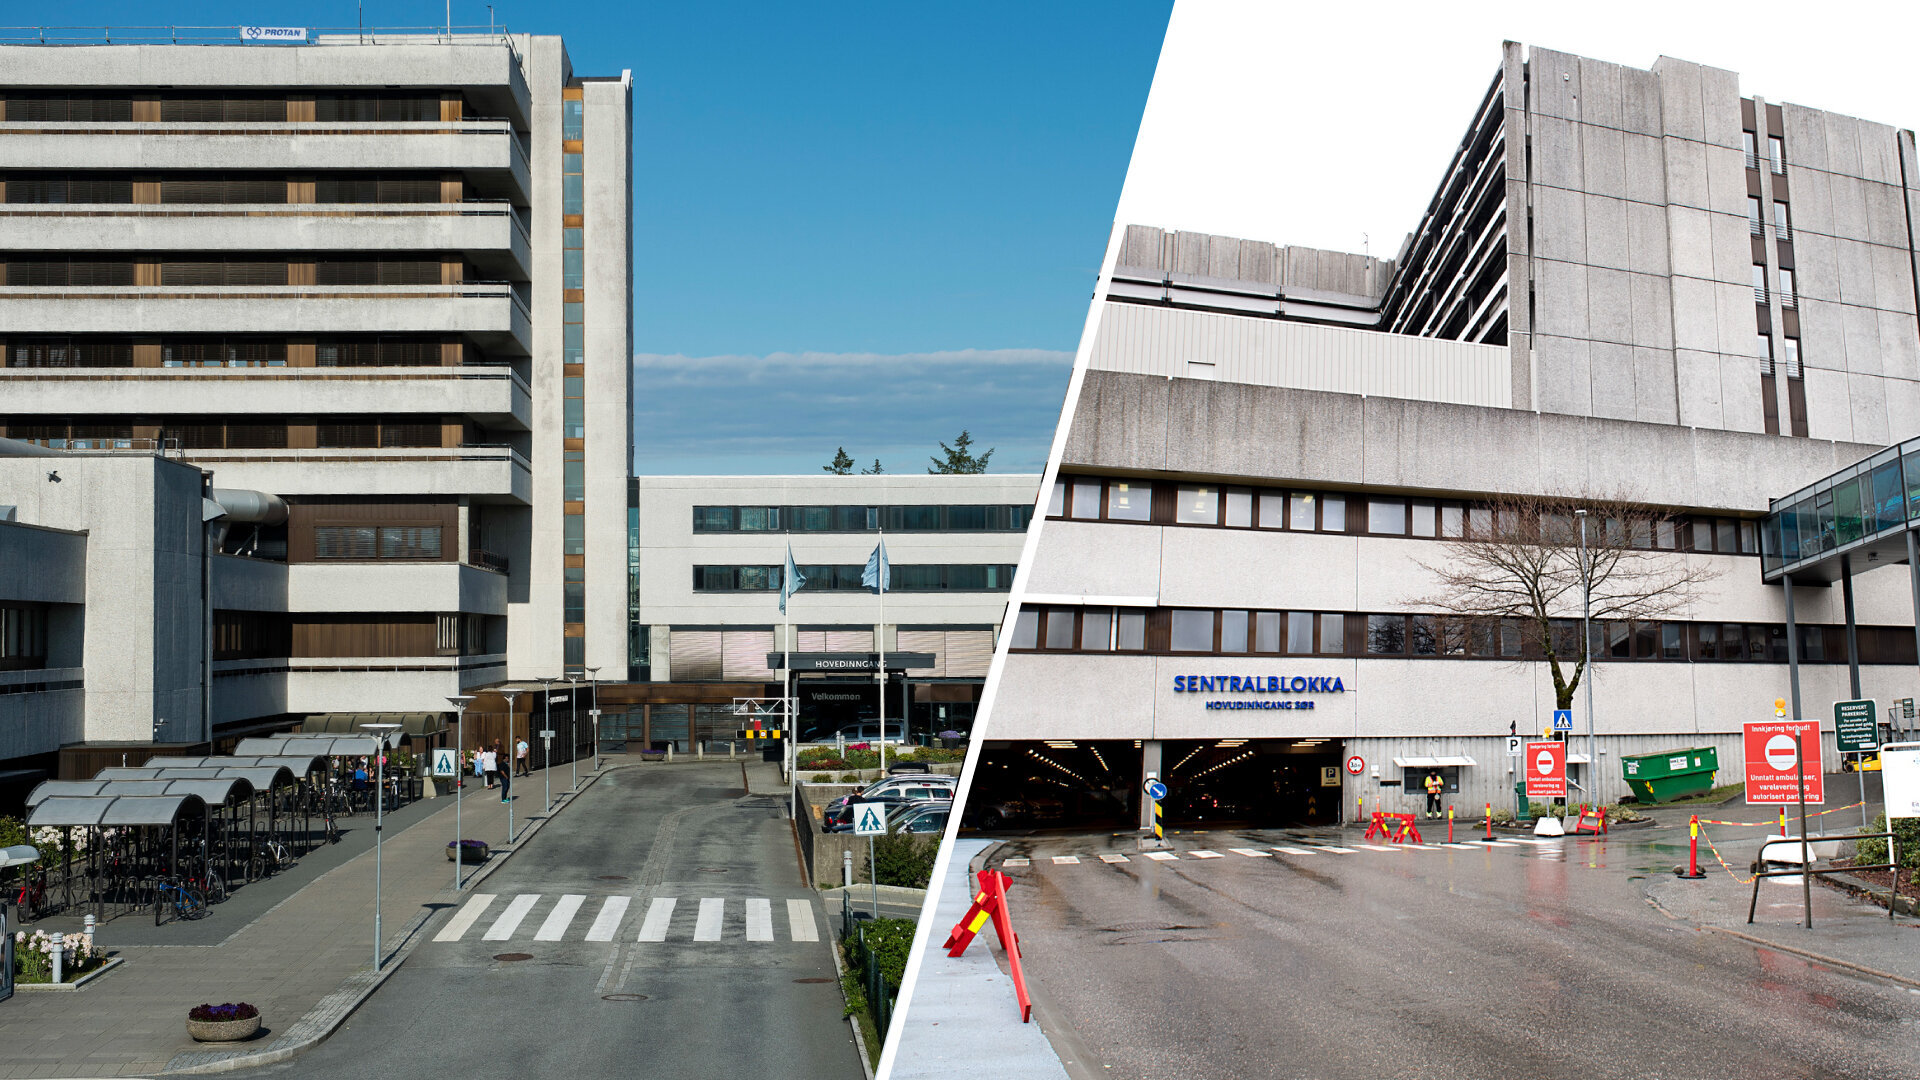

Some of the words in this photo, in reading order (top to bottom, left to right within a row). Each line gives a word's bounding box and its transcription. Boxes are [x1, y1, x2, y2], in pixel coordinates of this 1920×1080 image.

[1174, 676, 1344, 692] SENTRALBLOKKA
[1206, 701, 1292, 710] HOVUDINNGANG
[1295, 701, 1314, 710] SØR
[1510, 739, 1518, 751] P
